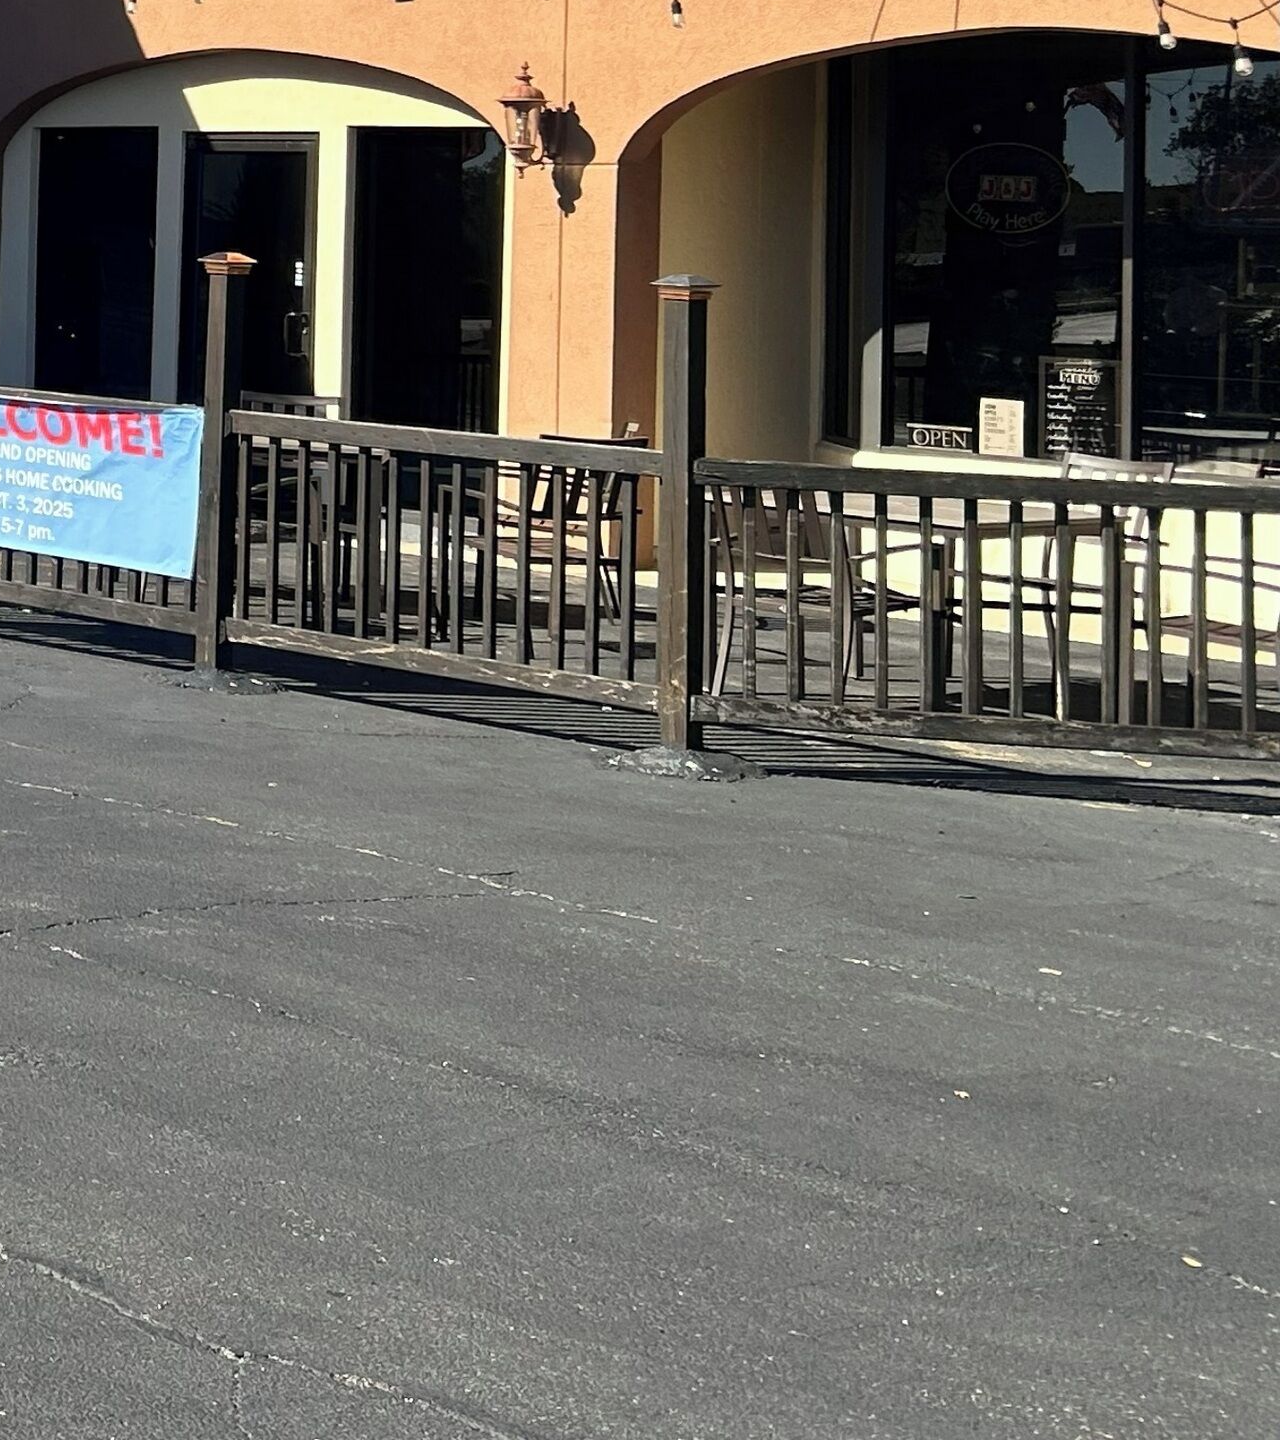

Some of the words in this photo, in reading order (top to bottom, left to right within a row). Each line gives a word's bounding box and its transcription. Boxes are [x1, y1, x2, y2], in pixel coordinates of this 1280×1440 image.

[913, 428, 966, 448] OPEN
[24, 446, 92, 471] OPENING
[5, 469, 50, 490] HOME
[52, 475, 124, 501] COOKING
[16, 494, 30, 514] 3,
[32, 498, 74, 520] 2025
[0, 516, 24, 536] 5-7
